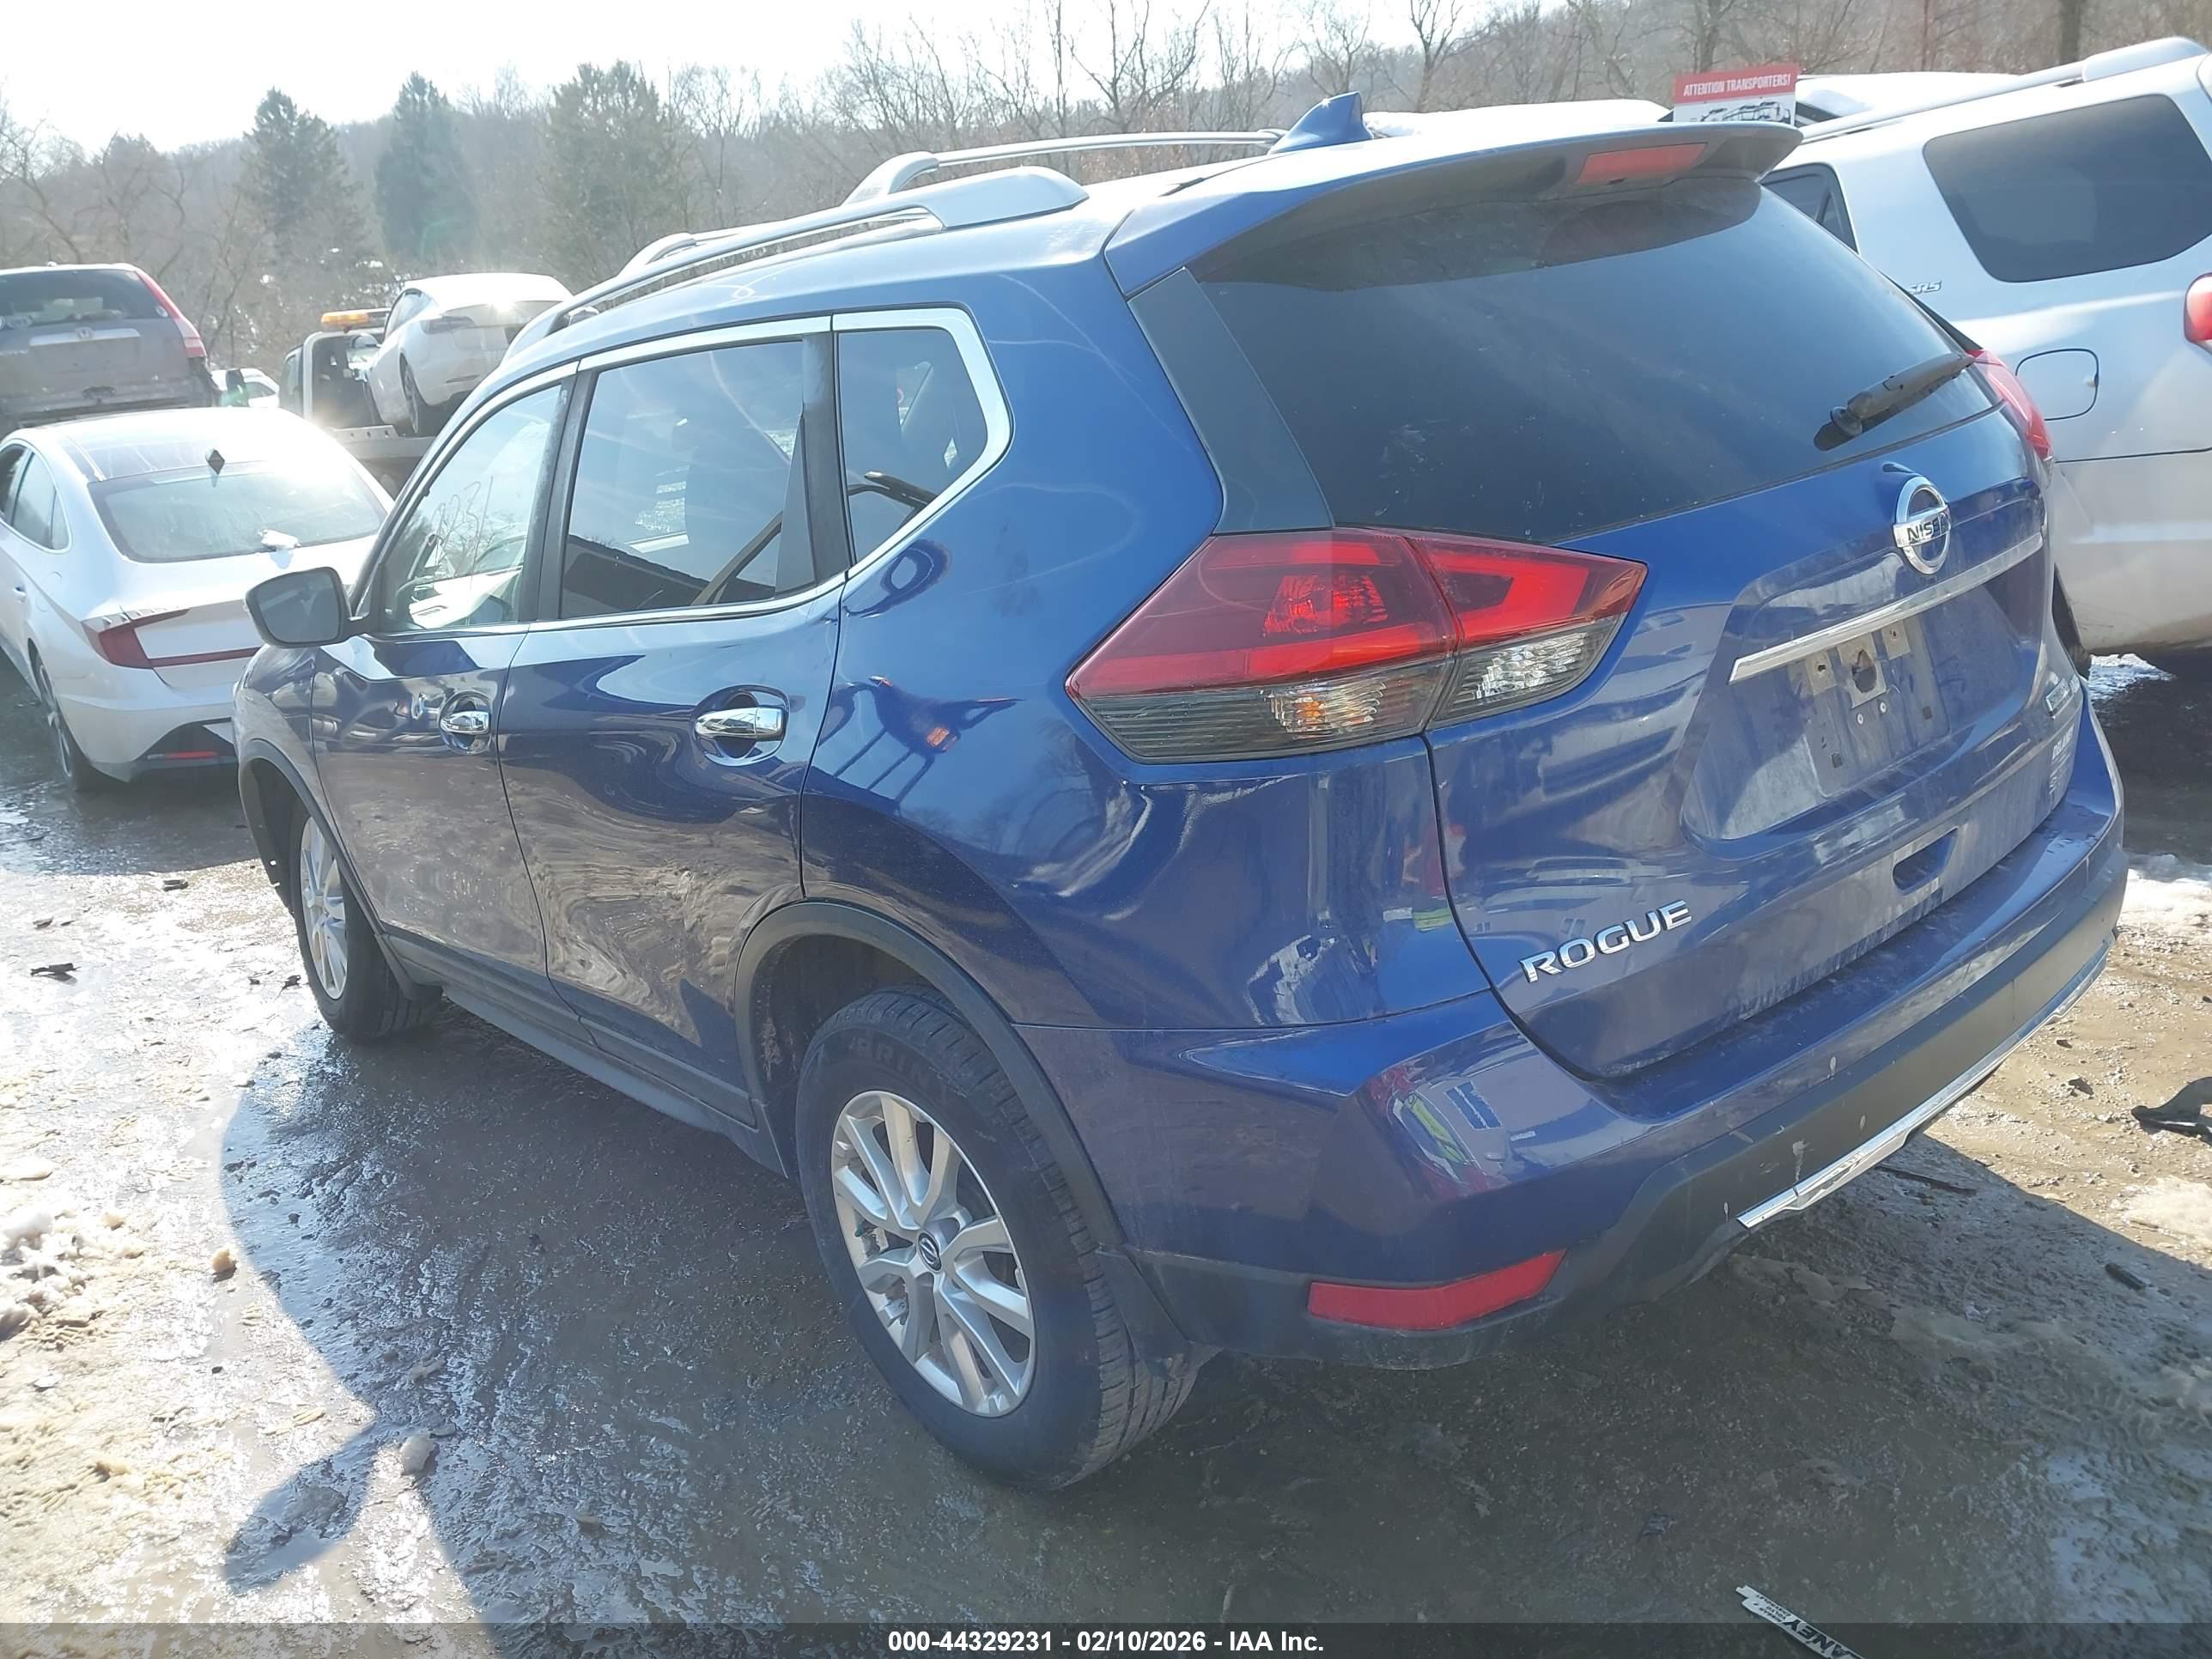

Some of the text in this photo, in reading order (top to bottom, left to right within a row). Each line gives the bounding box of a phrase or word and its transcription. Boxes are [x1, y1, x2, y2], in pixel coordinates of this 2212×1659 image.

[1683, 73, 1791, 97] ATTENTION TRANSPORTERS!
[1906, 514, 1948, 542] NISS
[1518, 900, 1692, 983] ROGUE
